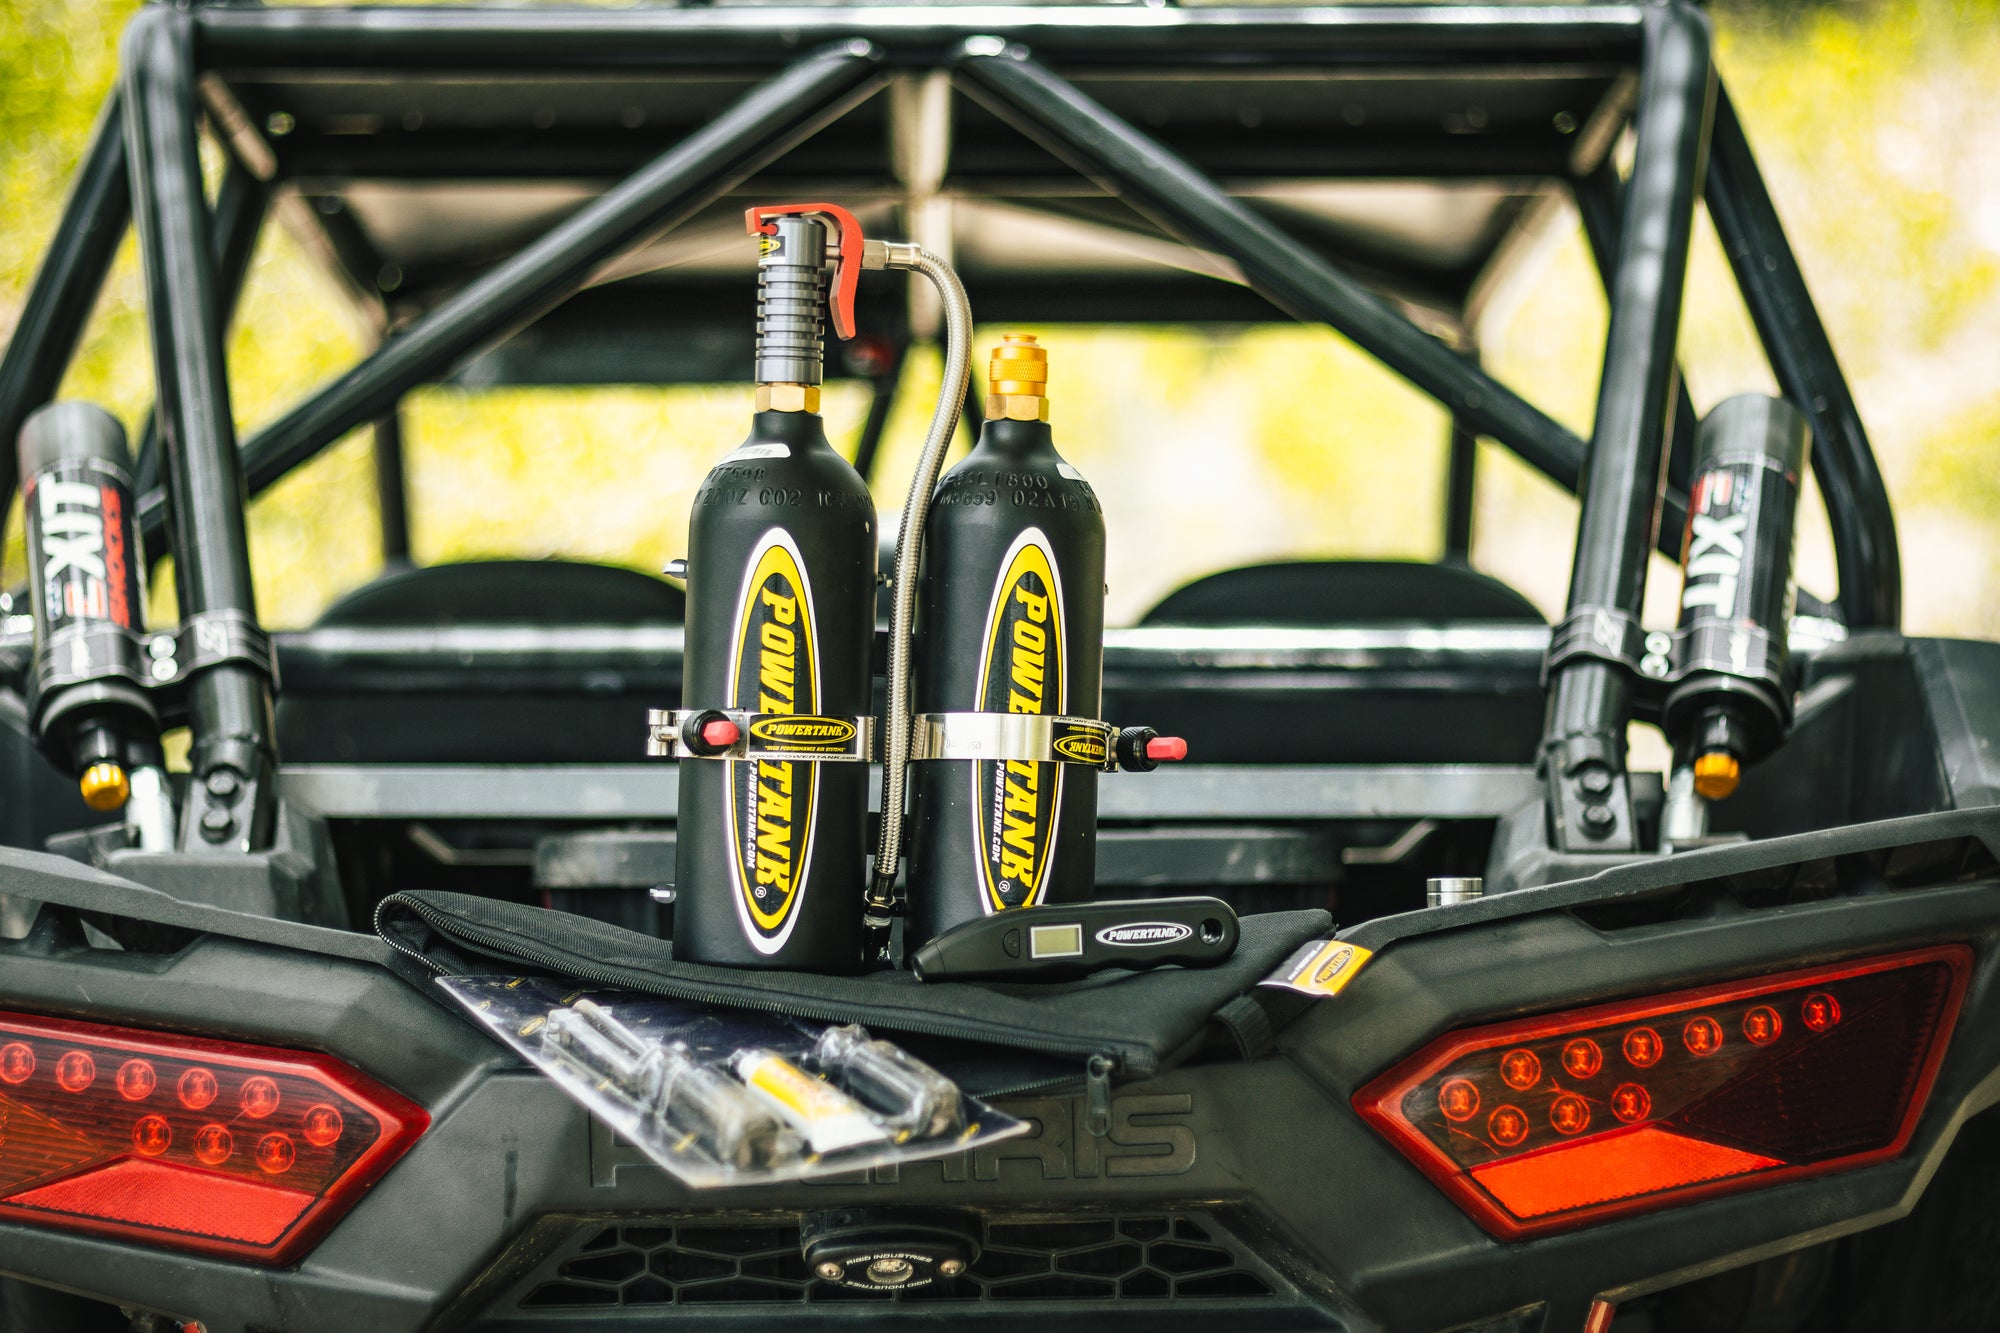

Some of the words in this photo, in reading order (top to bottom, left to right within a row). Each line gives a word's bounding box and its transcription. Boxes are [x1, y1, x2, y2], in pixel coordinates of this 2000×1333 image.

[39, 472, 108, 622] EXIT
[1682, 470, 1750, 619] EXIT
[756, 586, 796, 893] POWETANK
[765, 724, 843, 736] POWERTANK
[1000, 584, 1047, 888] POWETANK
[992, 760, 1004, 863] .POWERTANK.COM
[1108, 926, 1178, 941] POWERTANK
[846, 1255, 871, 1266] RIGID
[873, 1253, 933, 1263] INDUSTRIES
